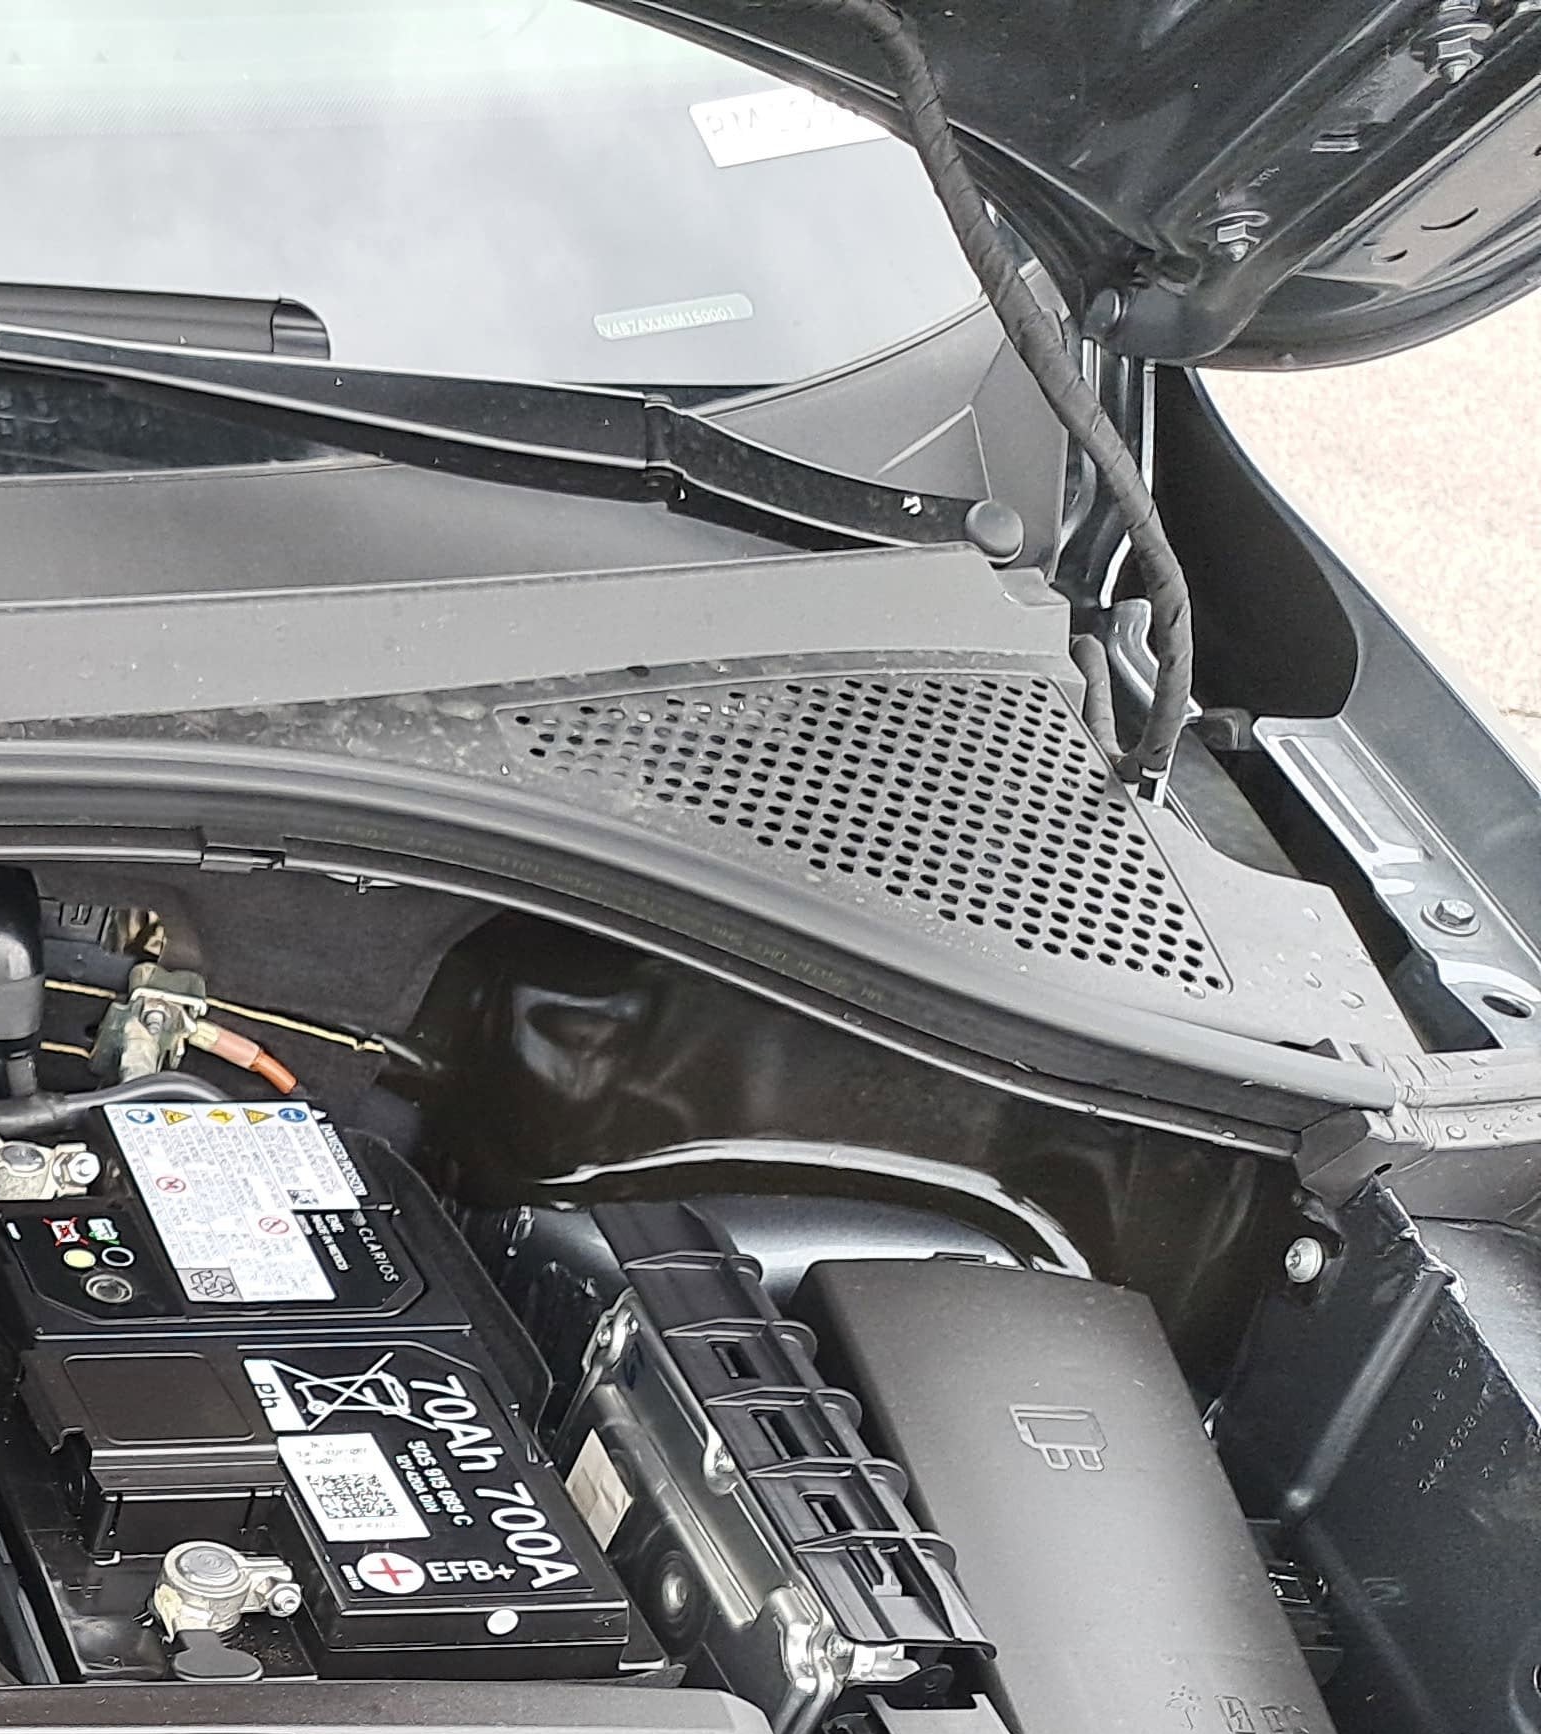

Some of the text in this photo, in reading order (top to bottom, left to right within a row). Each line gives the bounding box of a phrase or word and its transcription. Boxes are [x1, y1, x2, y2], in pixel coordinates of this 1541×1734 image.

[358, 1227, 400, 1283] CLARIOS
[410, 1374, 580, 1589] 70Ah 700A
[425, 1559, 518, 1583] EFB+
